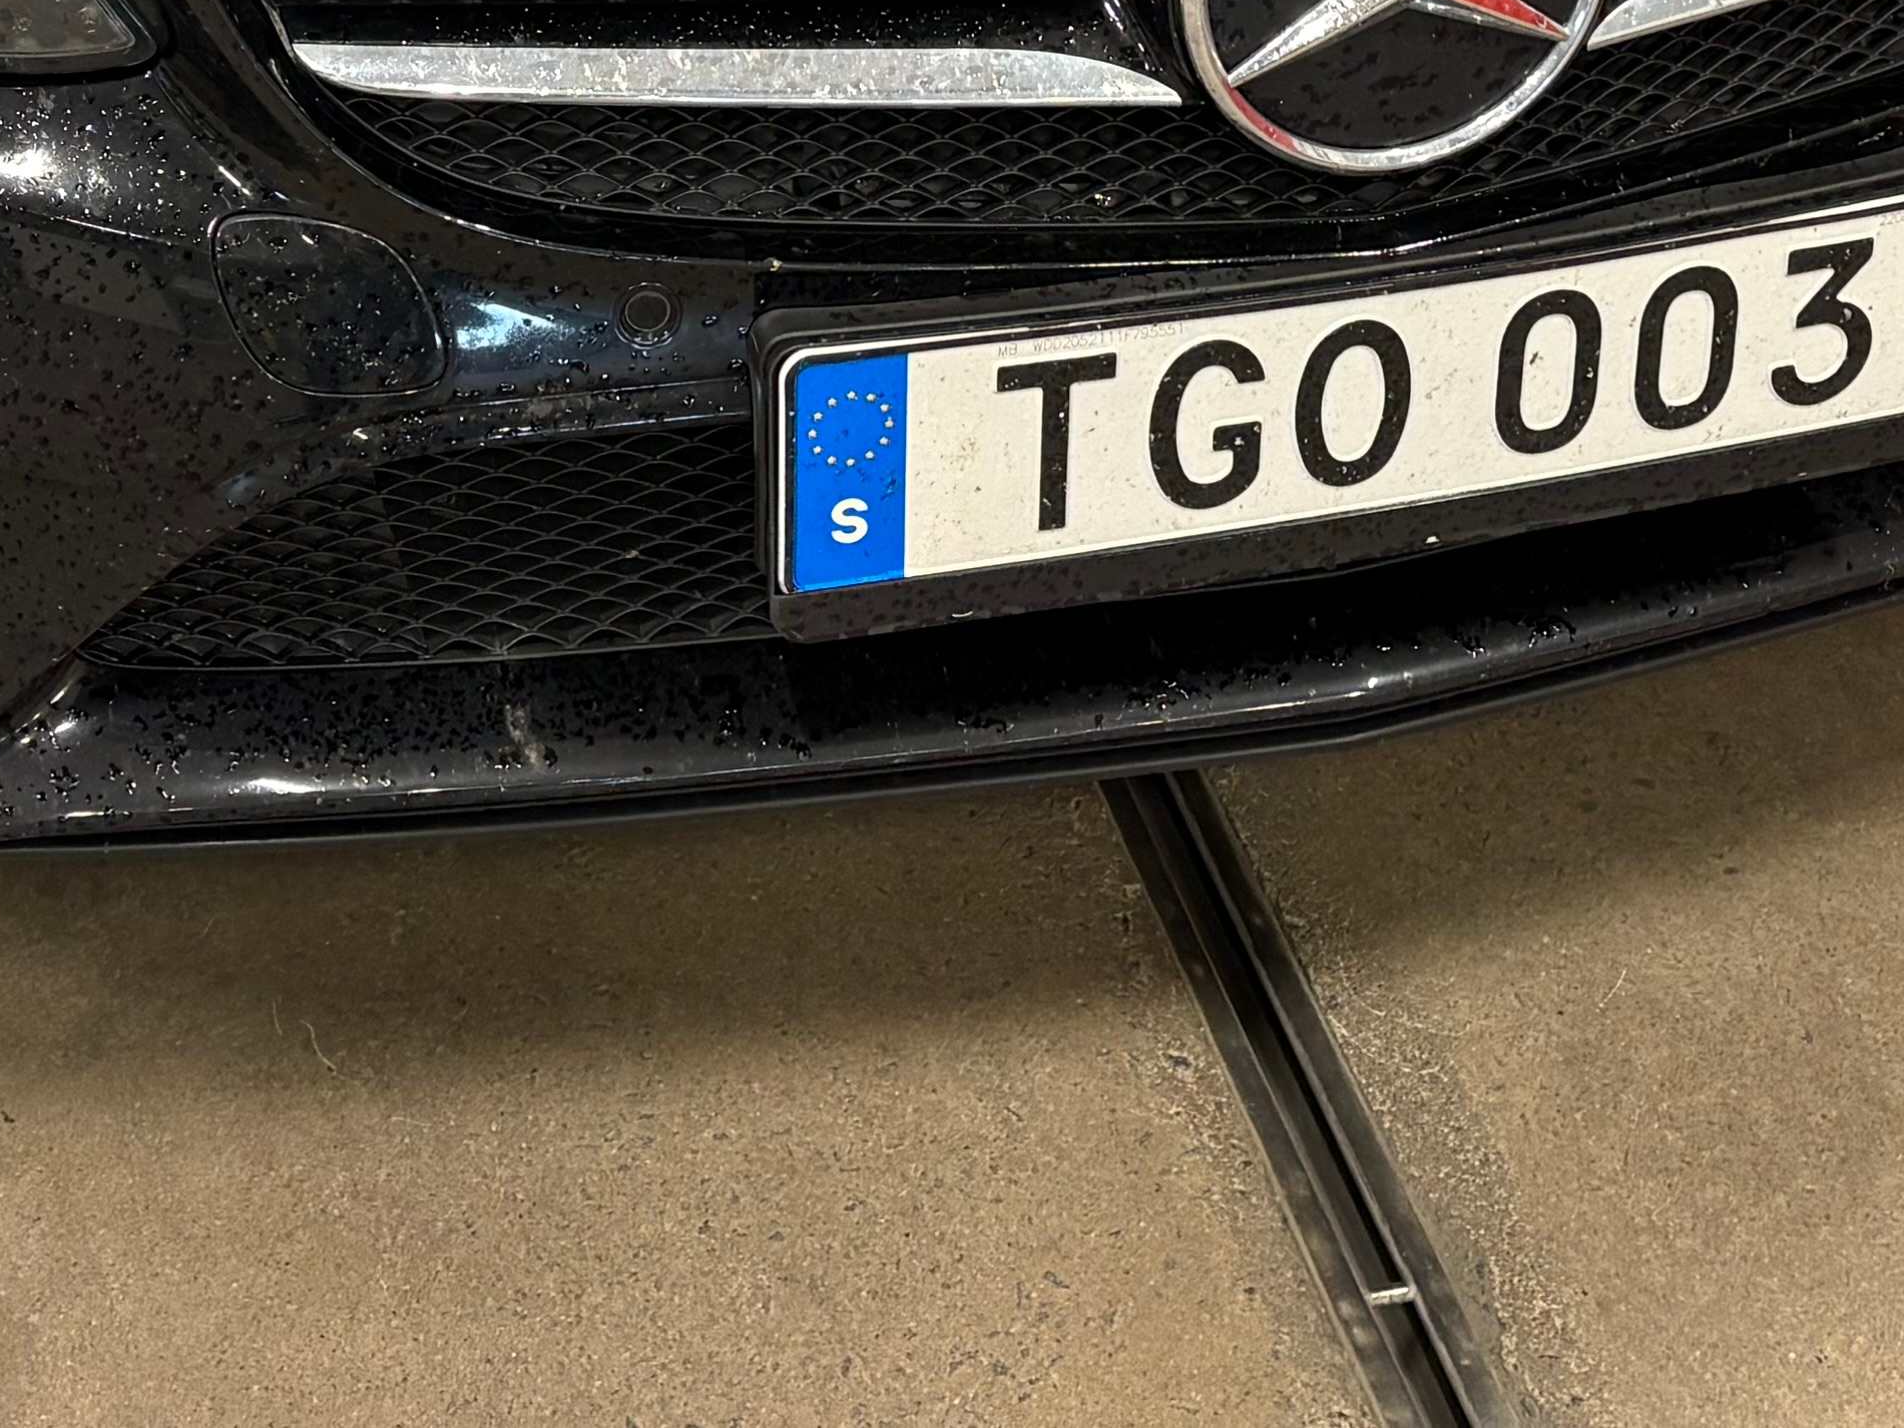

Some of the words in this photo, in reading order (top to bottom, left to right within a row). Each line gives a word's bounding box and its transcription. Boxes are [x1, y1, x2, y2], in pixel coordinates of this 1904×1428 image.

[997, 343, 1018, 357] MB
[996, 320, 1412, 532] TGO
[1494, 236, 1875, 456] 003
[829, 497, 869, 544] S
